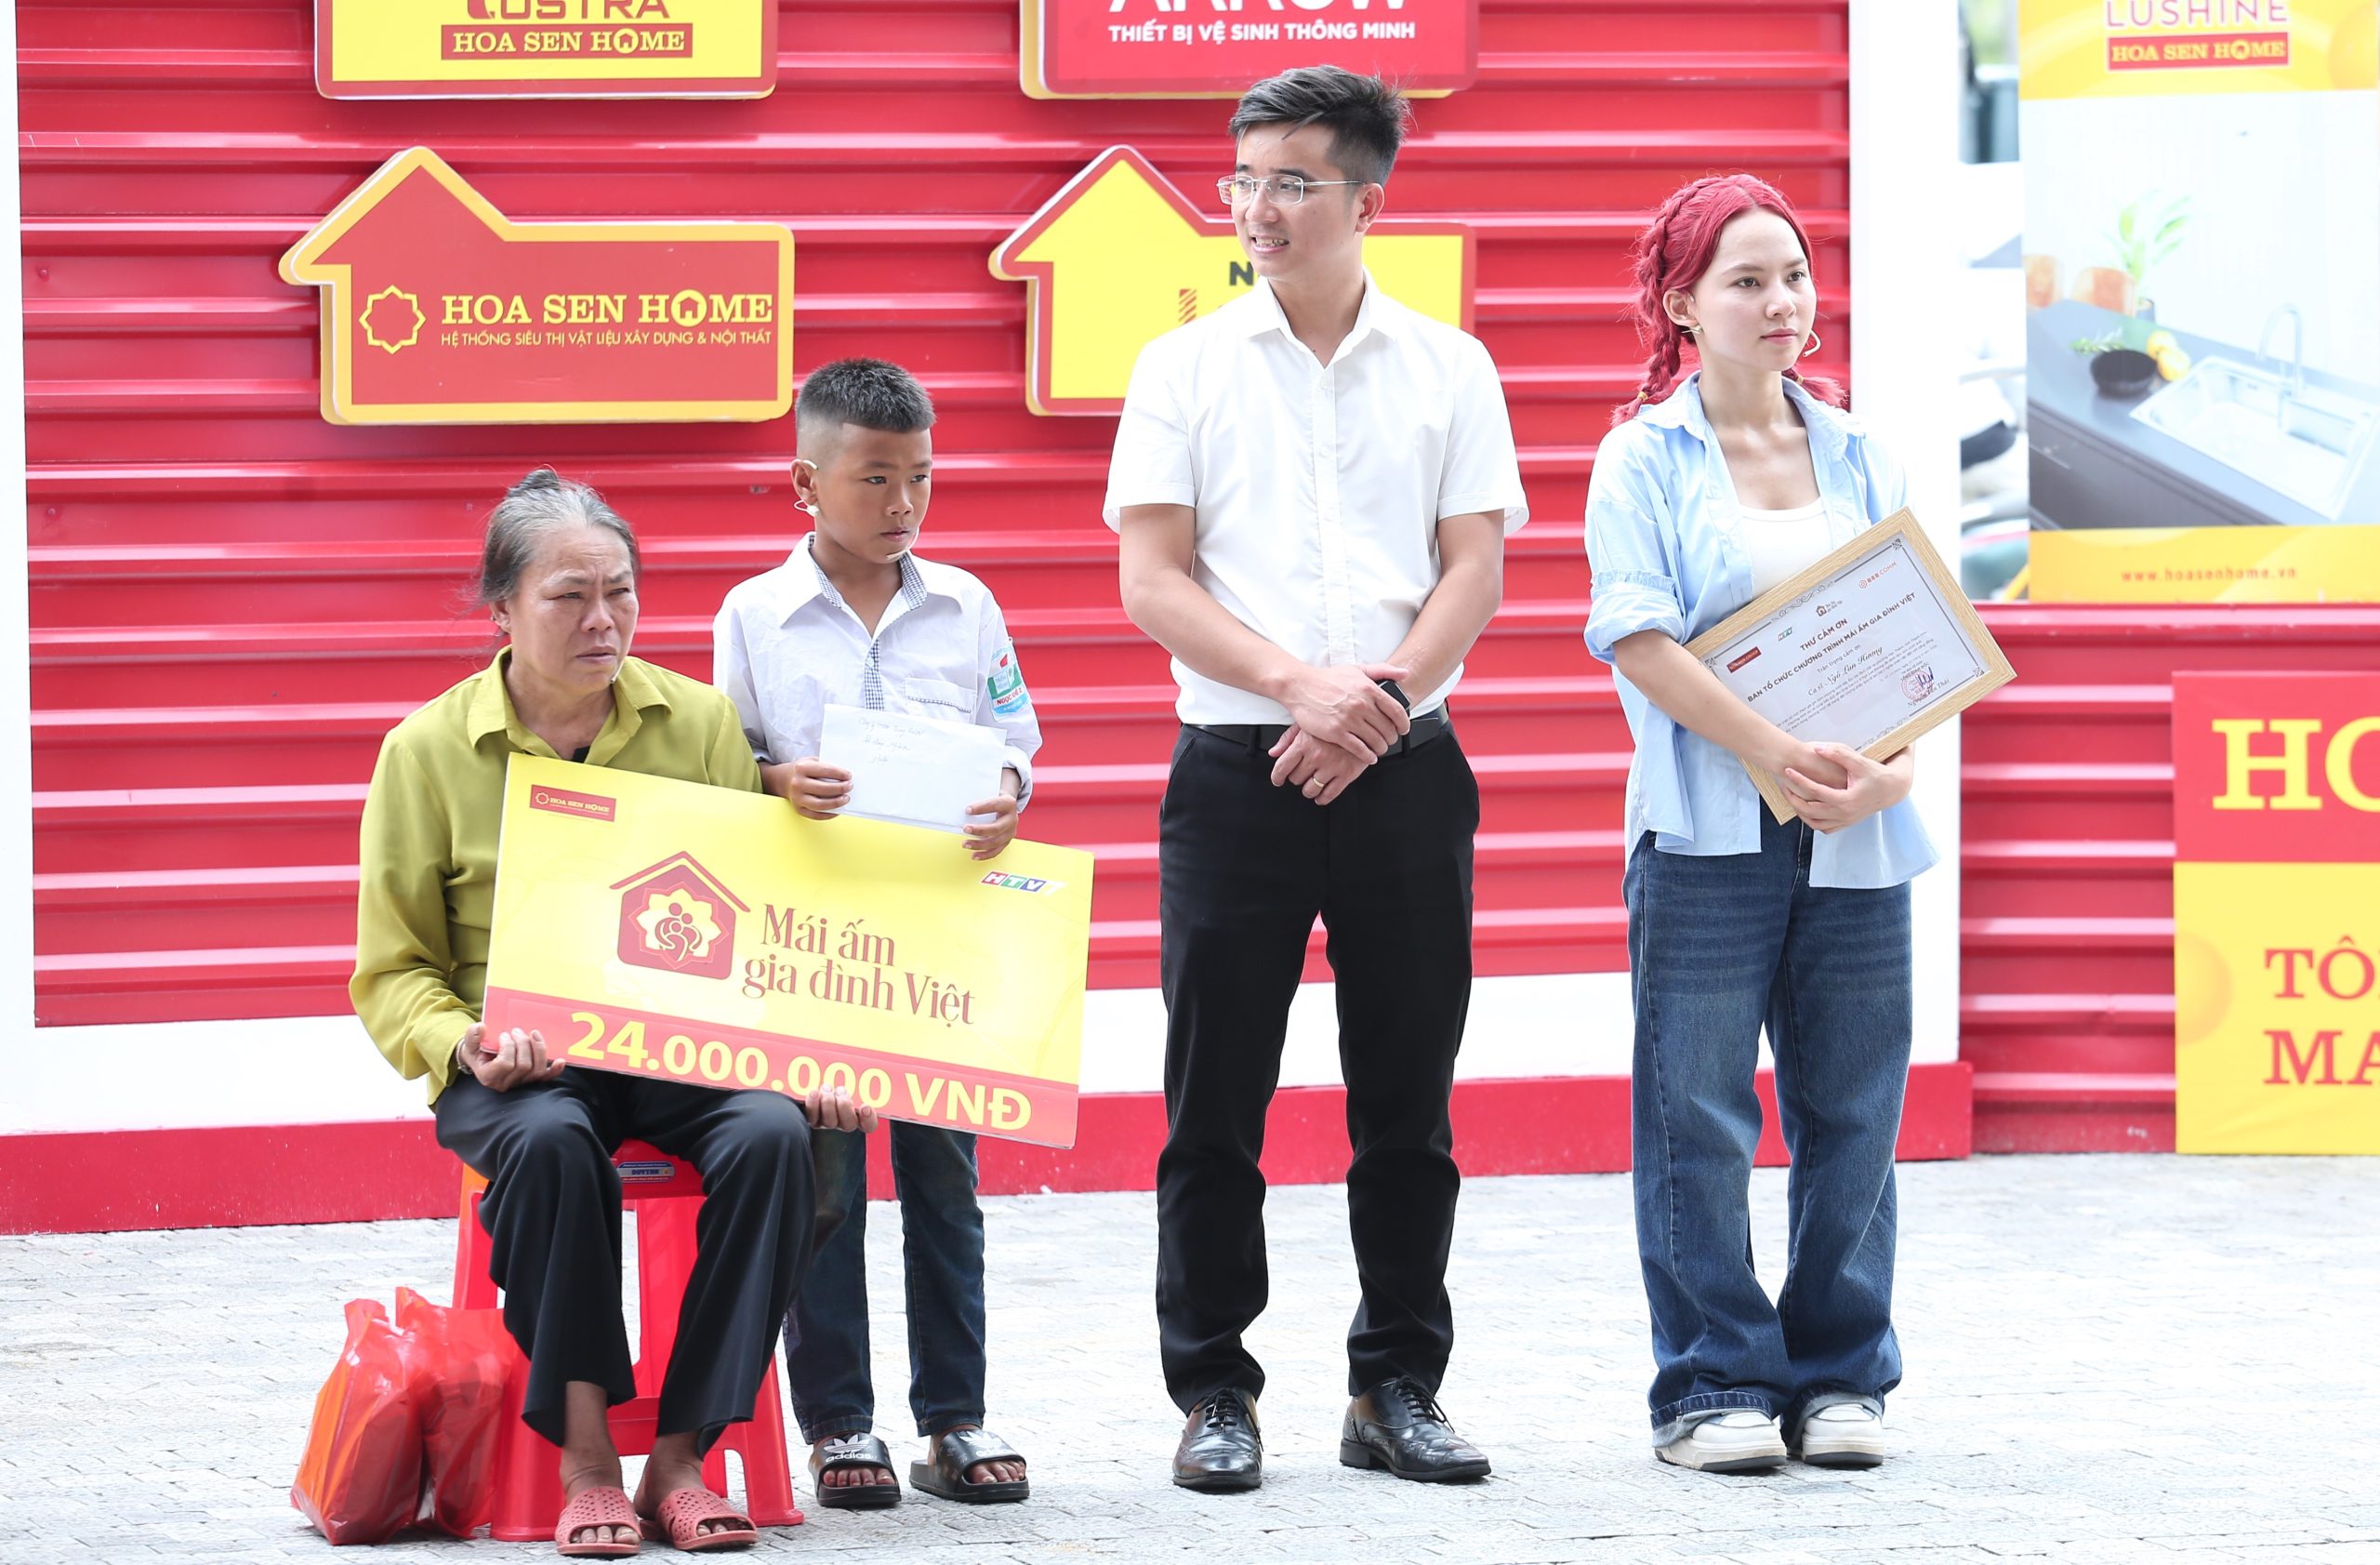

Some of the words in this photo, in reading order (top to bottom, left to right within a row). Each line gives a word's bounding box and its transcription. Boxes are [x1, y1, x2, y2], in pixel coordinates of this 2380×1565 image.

[2108, 0, 2287, 27] LUSHINE
[453, 32, 516, 53] HOA
[523, 31, 583, 52] SEN
[590, 28, 685, 54] HOME
[1108, 19, 1168, 42] THIẾT
[1172, 24, 1193, 45] BỊ
[1198, 20, 1226, 45] VỆ
[1231, 23, 1279, 40] SINH
[1284, 19, 1357, 40] THÔNG
[1363, 22, 1415, 39] MINH
[2111, 45, 2159, 62] HOA
[2163, 43, 2208, 60] SEN
[2214, 40, 2285, 60] HOME
[442, 295, 533, 325] HOA
[543, 294, 628, 324] SEN
[638, 289, 773, 327] HOME
[441, 330, 459, 349] HỆ
[462, 329, 511, 346] THỐNG
[515, 330, 542, 345] SIÊU
[546, 332, 565, 348] THỊ
[569, 329, 593, 348] VẬT
[596, 329, 621, 348] LIỆU
[624, 329, 650, 345] XÂY
[654, 331, 694, 347] DỰNG
[697, 331, 707, 344] &
[710, 329, 736, 346] NỘI
[740, 328, 772, 345] THẤT
[2121, 567, 2297, 581] www.hoasenhome.vn
[1800, 638, 1817, 650] THƯ
[1748, 690, 1762, 701] BAN
[760, 904, 826, 955] Mái
[838, 919, 895, 967] ấm
[2265, 935, 2380, 1000] TÔ
[742, 954, 798, 999] gia
[810, 959, 894, 1011] đình
[904, 972, 975, 1028] Việt
[568, 1012, 892, 1108] 24.000.000
[905, 1072, 1032, 1131] VNĐ
